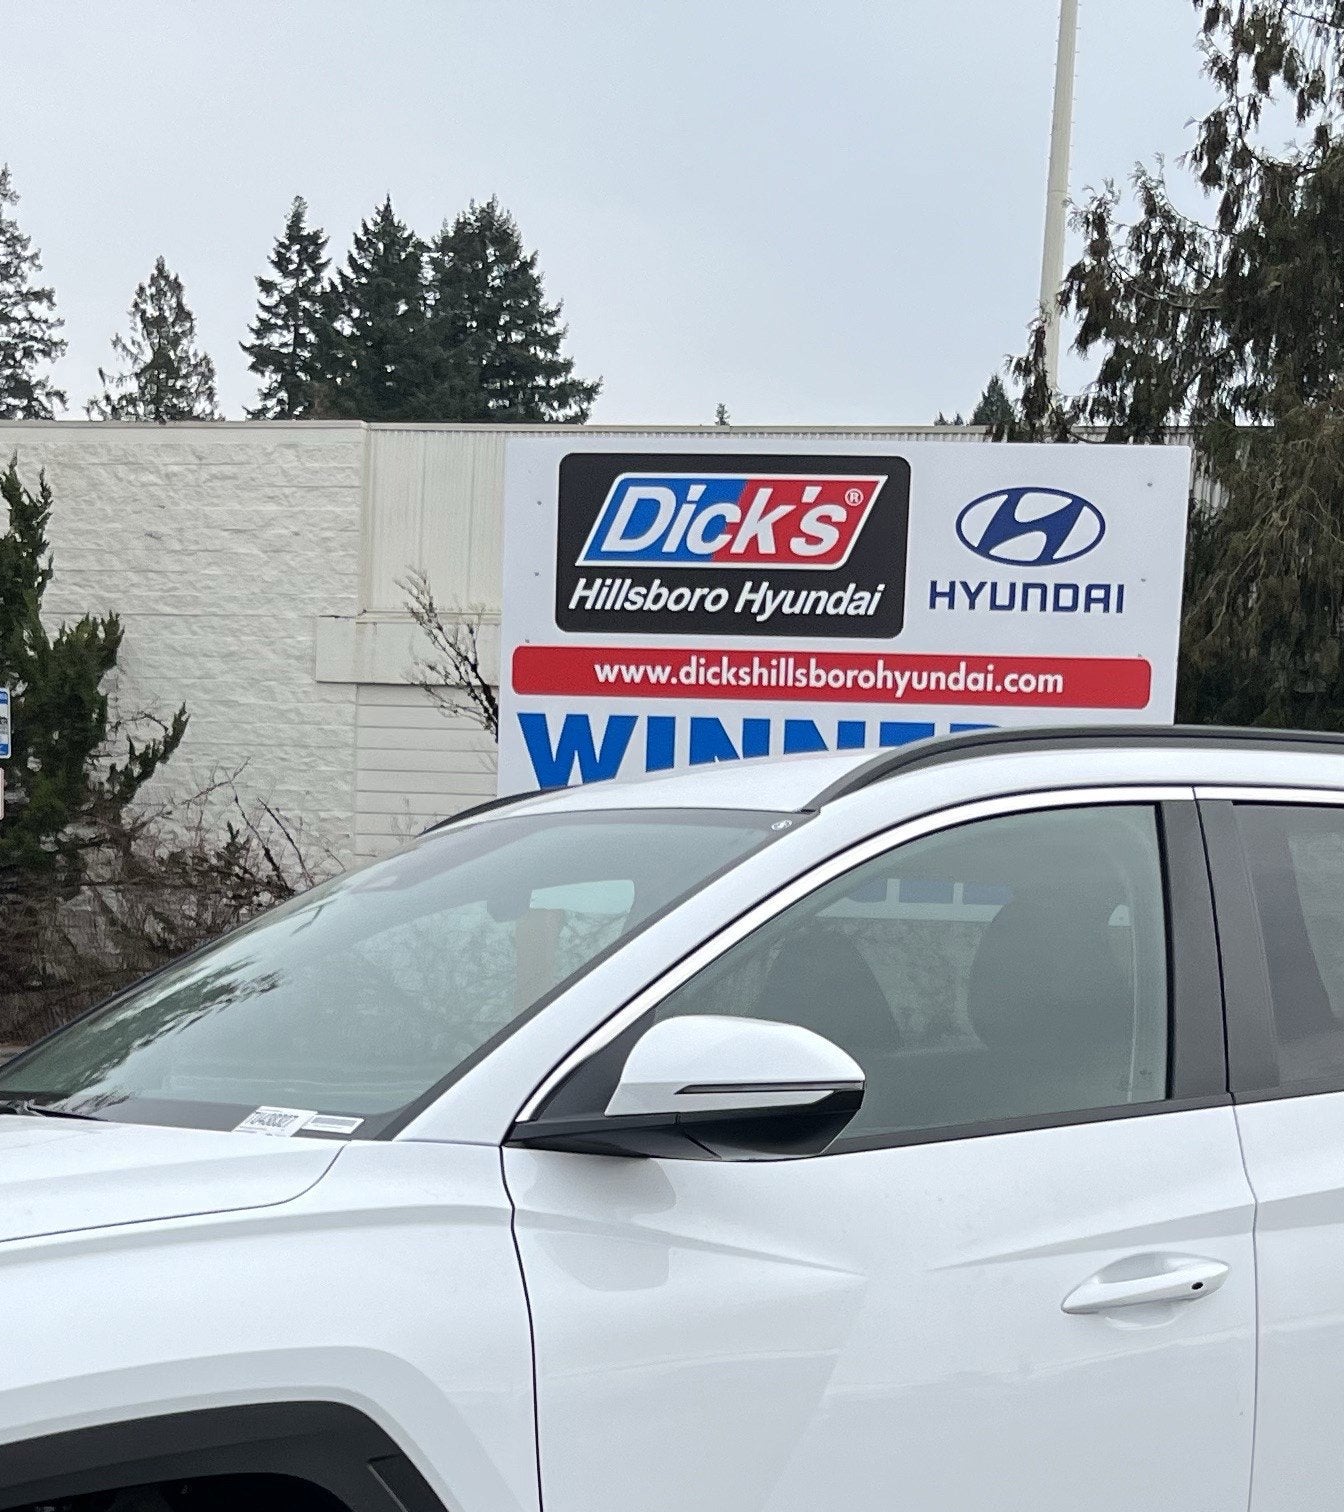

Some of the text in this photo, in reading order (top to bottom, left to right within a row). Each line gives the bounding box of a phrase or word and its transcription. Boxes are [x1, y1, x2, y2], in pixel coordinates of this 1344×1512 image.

[568, 577, 886, 622] Hillsboro Hyundai
[929, 580, 1125, 614] HYUNDAI
[593, 656, 1065, 699] www.dickshillsborohyundai.com
